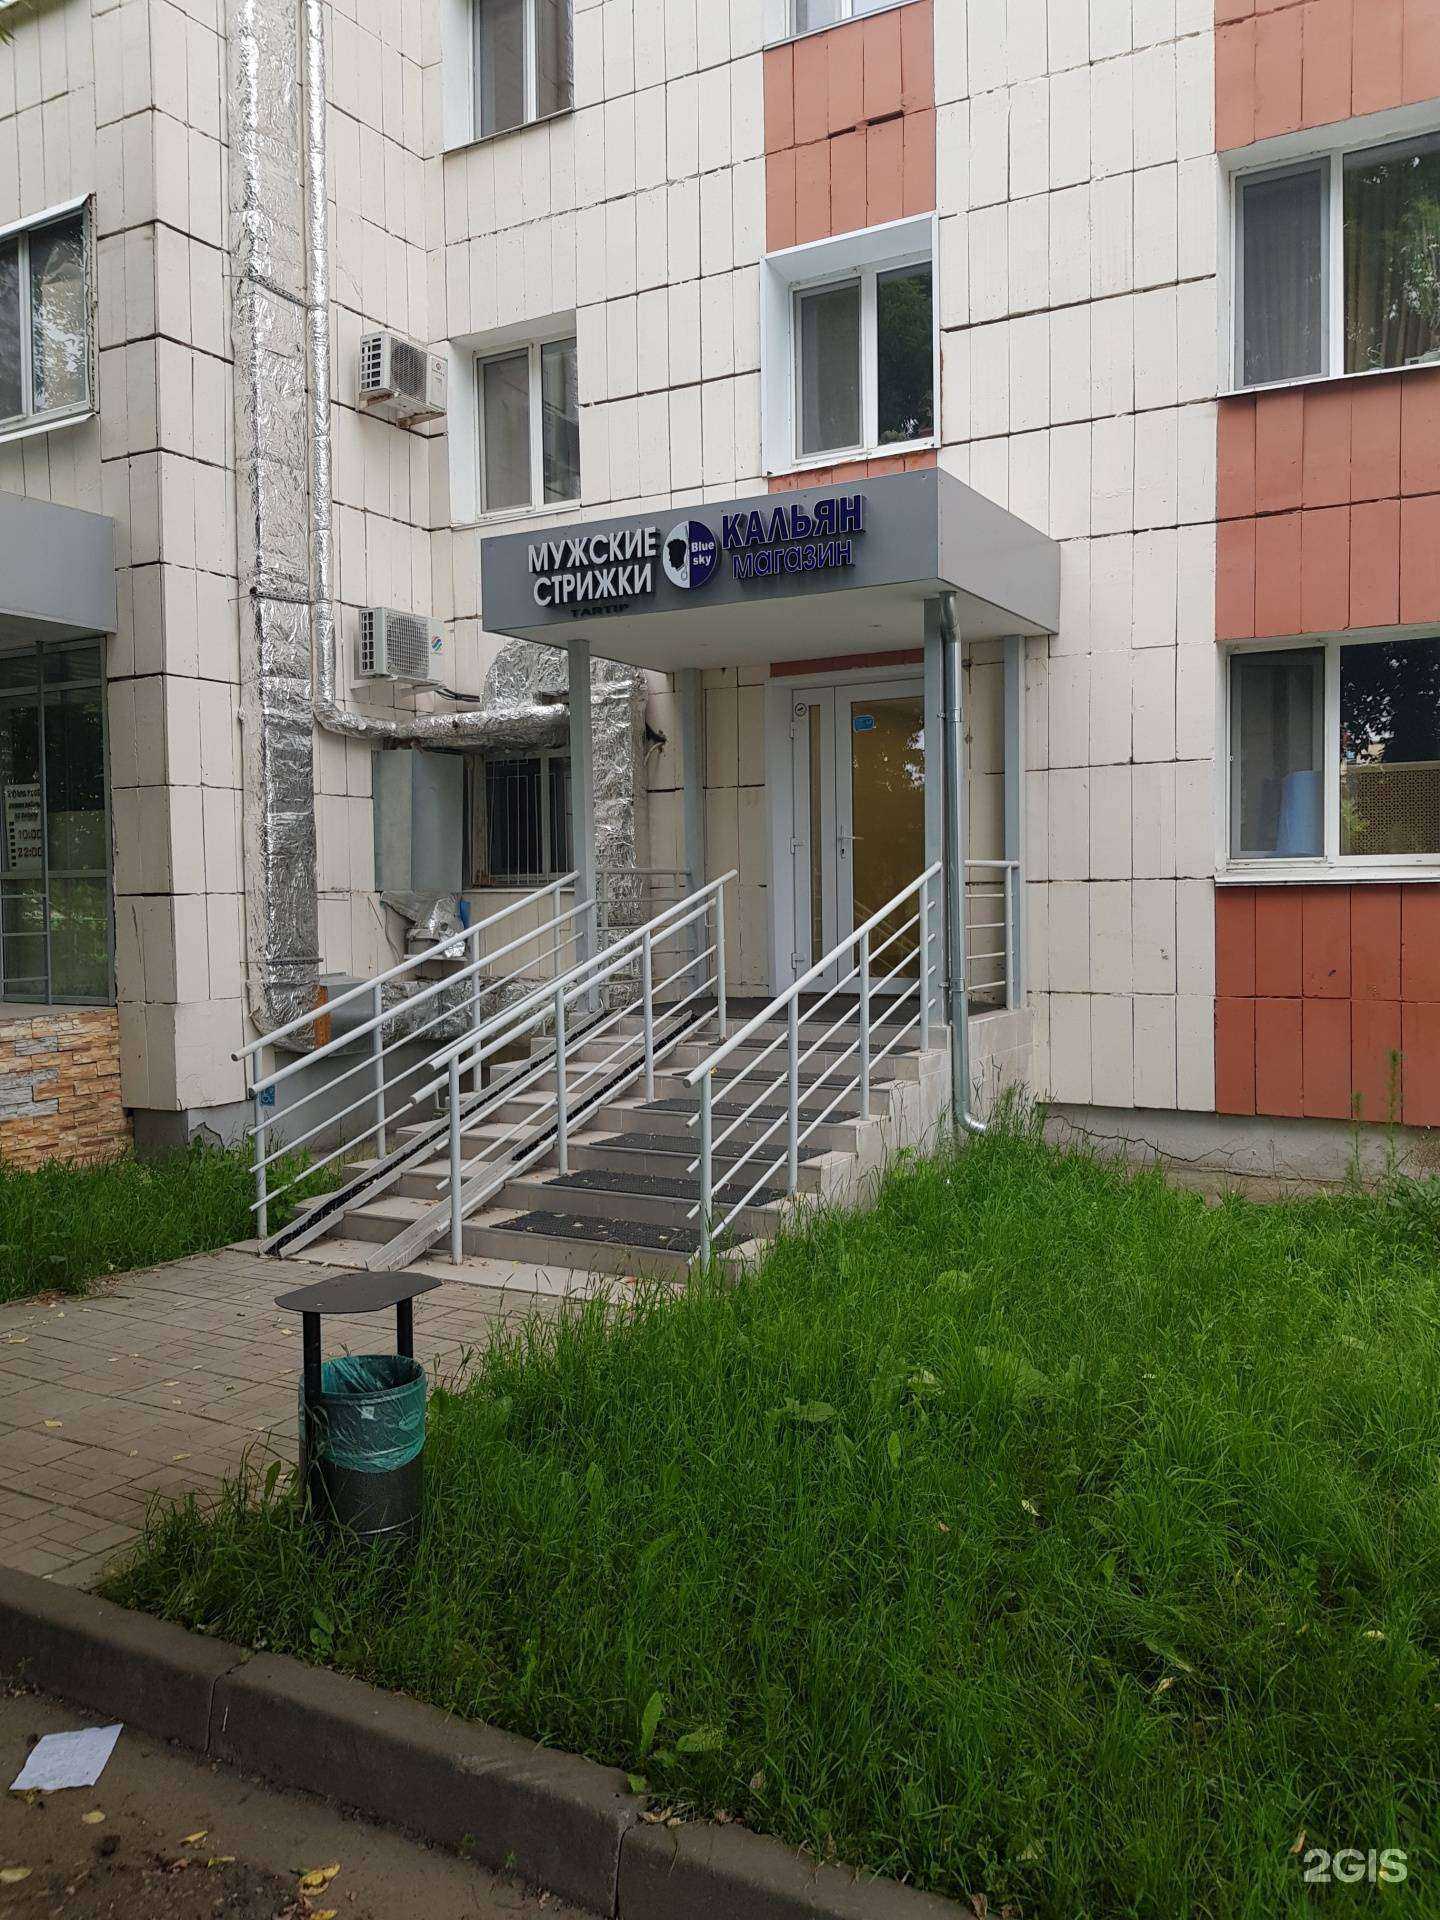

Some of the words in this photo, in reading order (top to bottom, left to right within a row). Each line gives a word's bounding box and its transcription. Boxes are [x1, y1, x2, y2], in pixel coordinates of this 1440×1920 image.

[722, 494, 864, 550] КАЛЬЯН
[528, 526, 657, 573] МУЖСКИЕ
[691, 541, 715, 553] Blue
[693, 554, 712, 566] sky
[732, 540, 853, 580] магазин
[533, 563, 652, 607] СТРИЖКИ
